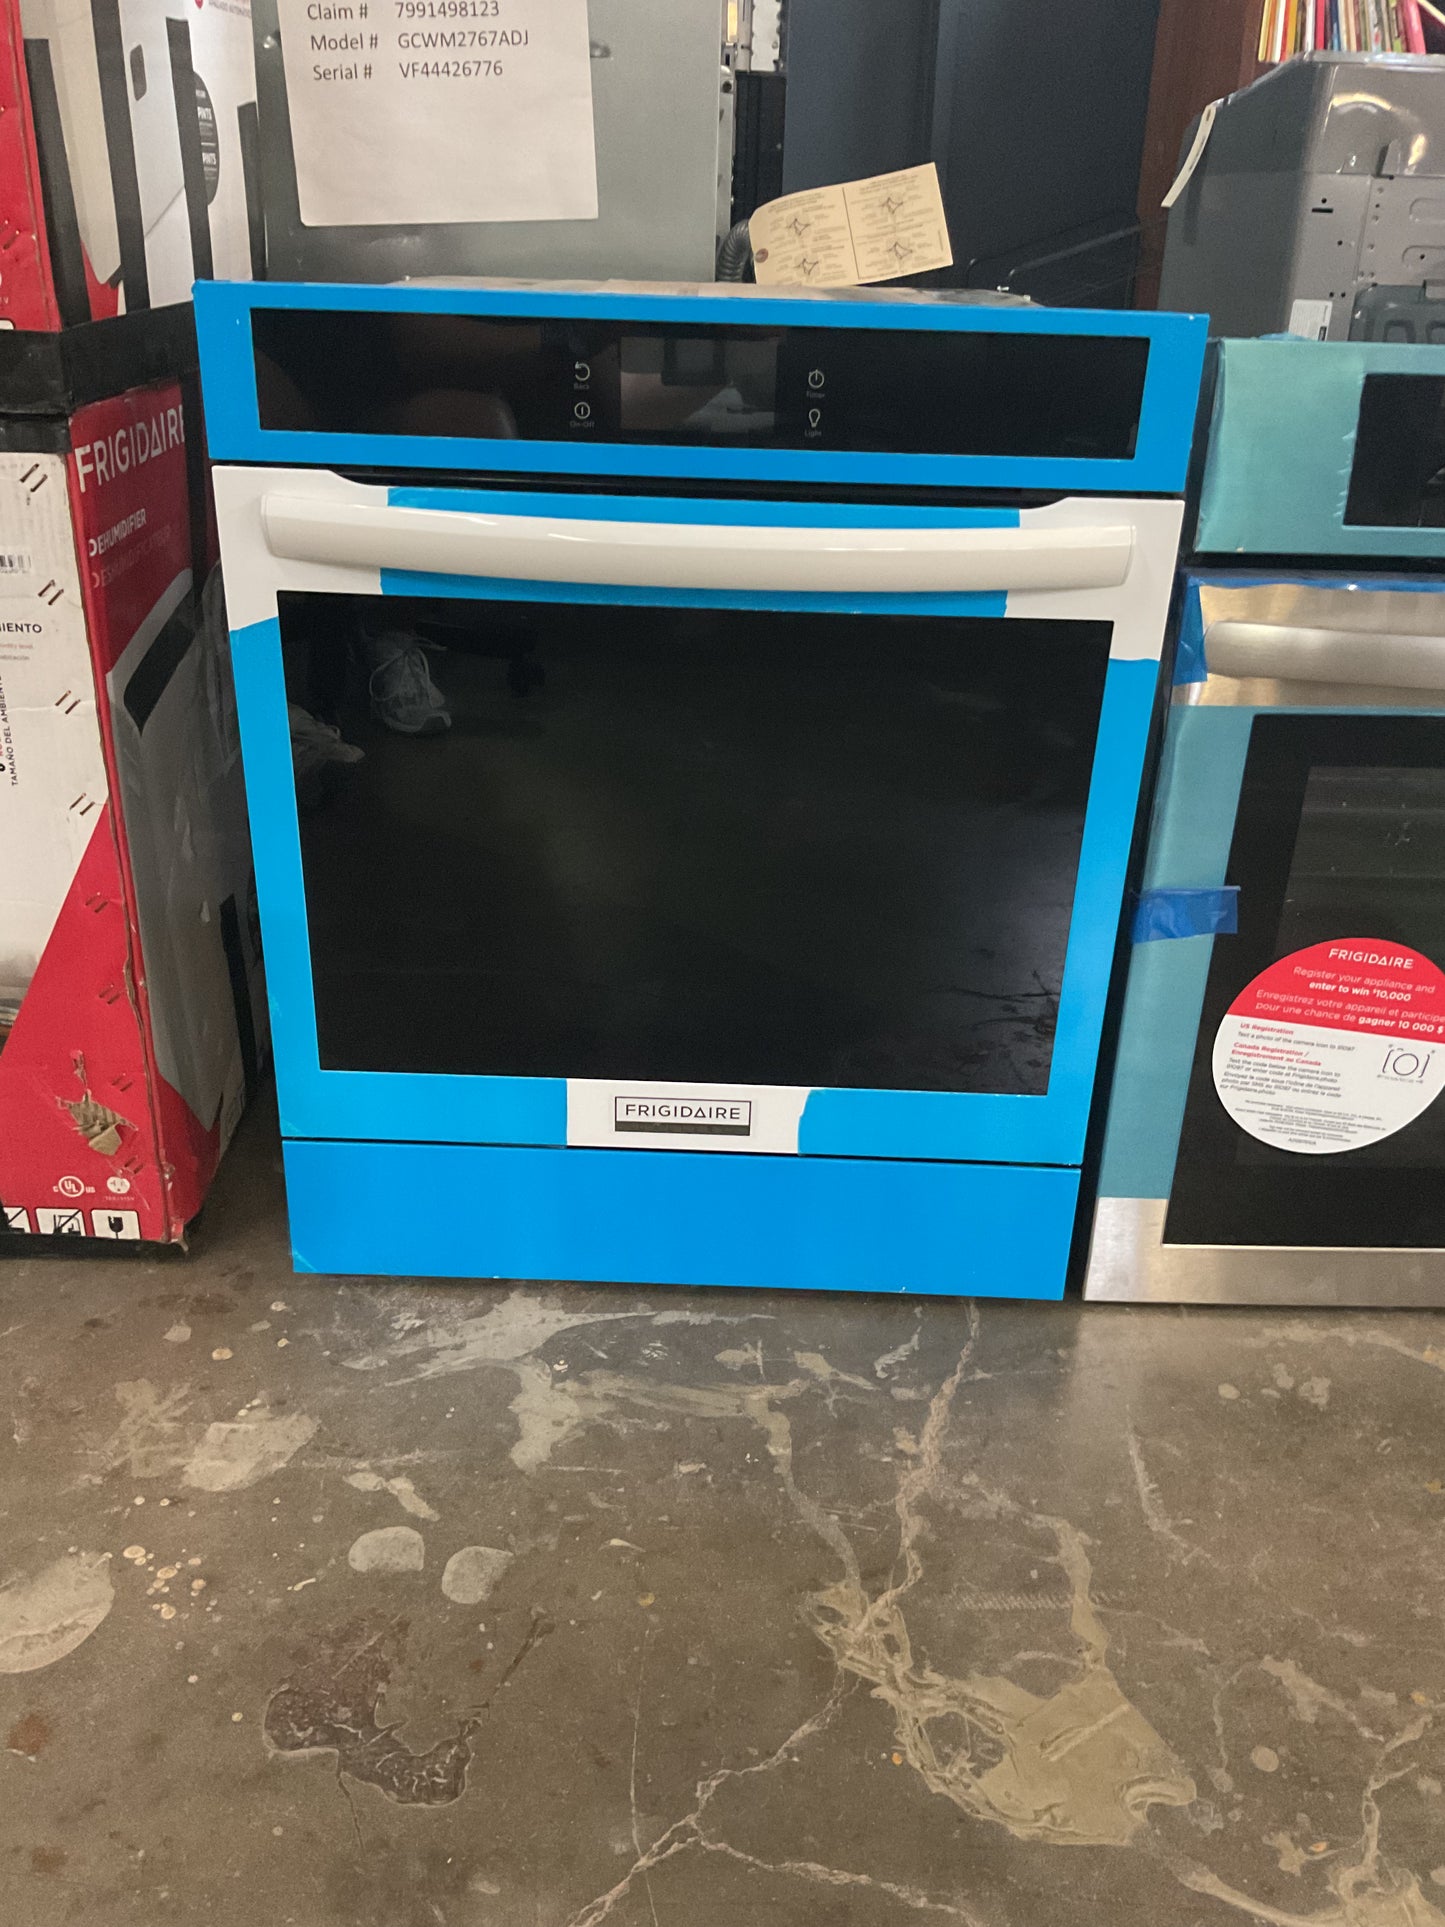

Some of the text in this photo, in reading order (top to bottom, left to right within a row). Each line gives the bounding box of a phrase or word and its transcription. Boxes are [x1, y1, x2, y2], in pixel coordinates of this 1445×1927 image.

[307, 1, 500, 20] Claim # 7991498123
[311, 30, 529, 50] Model # GCWM2767ADJ
[313, 60, 503, 81] Serial # VF44426776
[0, 622, 42, 633] IENTO
[1328, 948, 1414, 969] FRIGIDAIRE
[1293, 966, 1436, 994] Register your appliance and
[1309, 982, 1411, 1002] enter to win $10,000
[1256, 990, 1314, 1006] Enregistrez
[1317, 997, 1343, 1008] votre
[1345, 1001, 1386, 1016] appareil
[1389, 1008, 1399, 1017] et
[1255, 1002, 1444, 1035] pour une chance de gagner 10 000 $
[1252, 1024, 1294, 1035] Registration
[1231, 1049, 1284, 1062] Enregistrement
[1295, 1057, 1322, 1066] Canada
[1233, 1041, 1260, 1050] Canada
[1261, 1045, 1303, 1057] Registration
[626, 1104, 740, 1120] FRIGIDAIRE
[64, 1180, 79, 1193] UL
